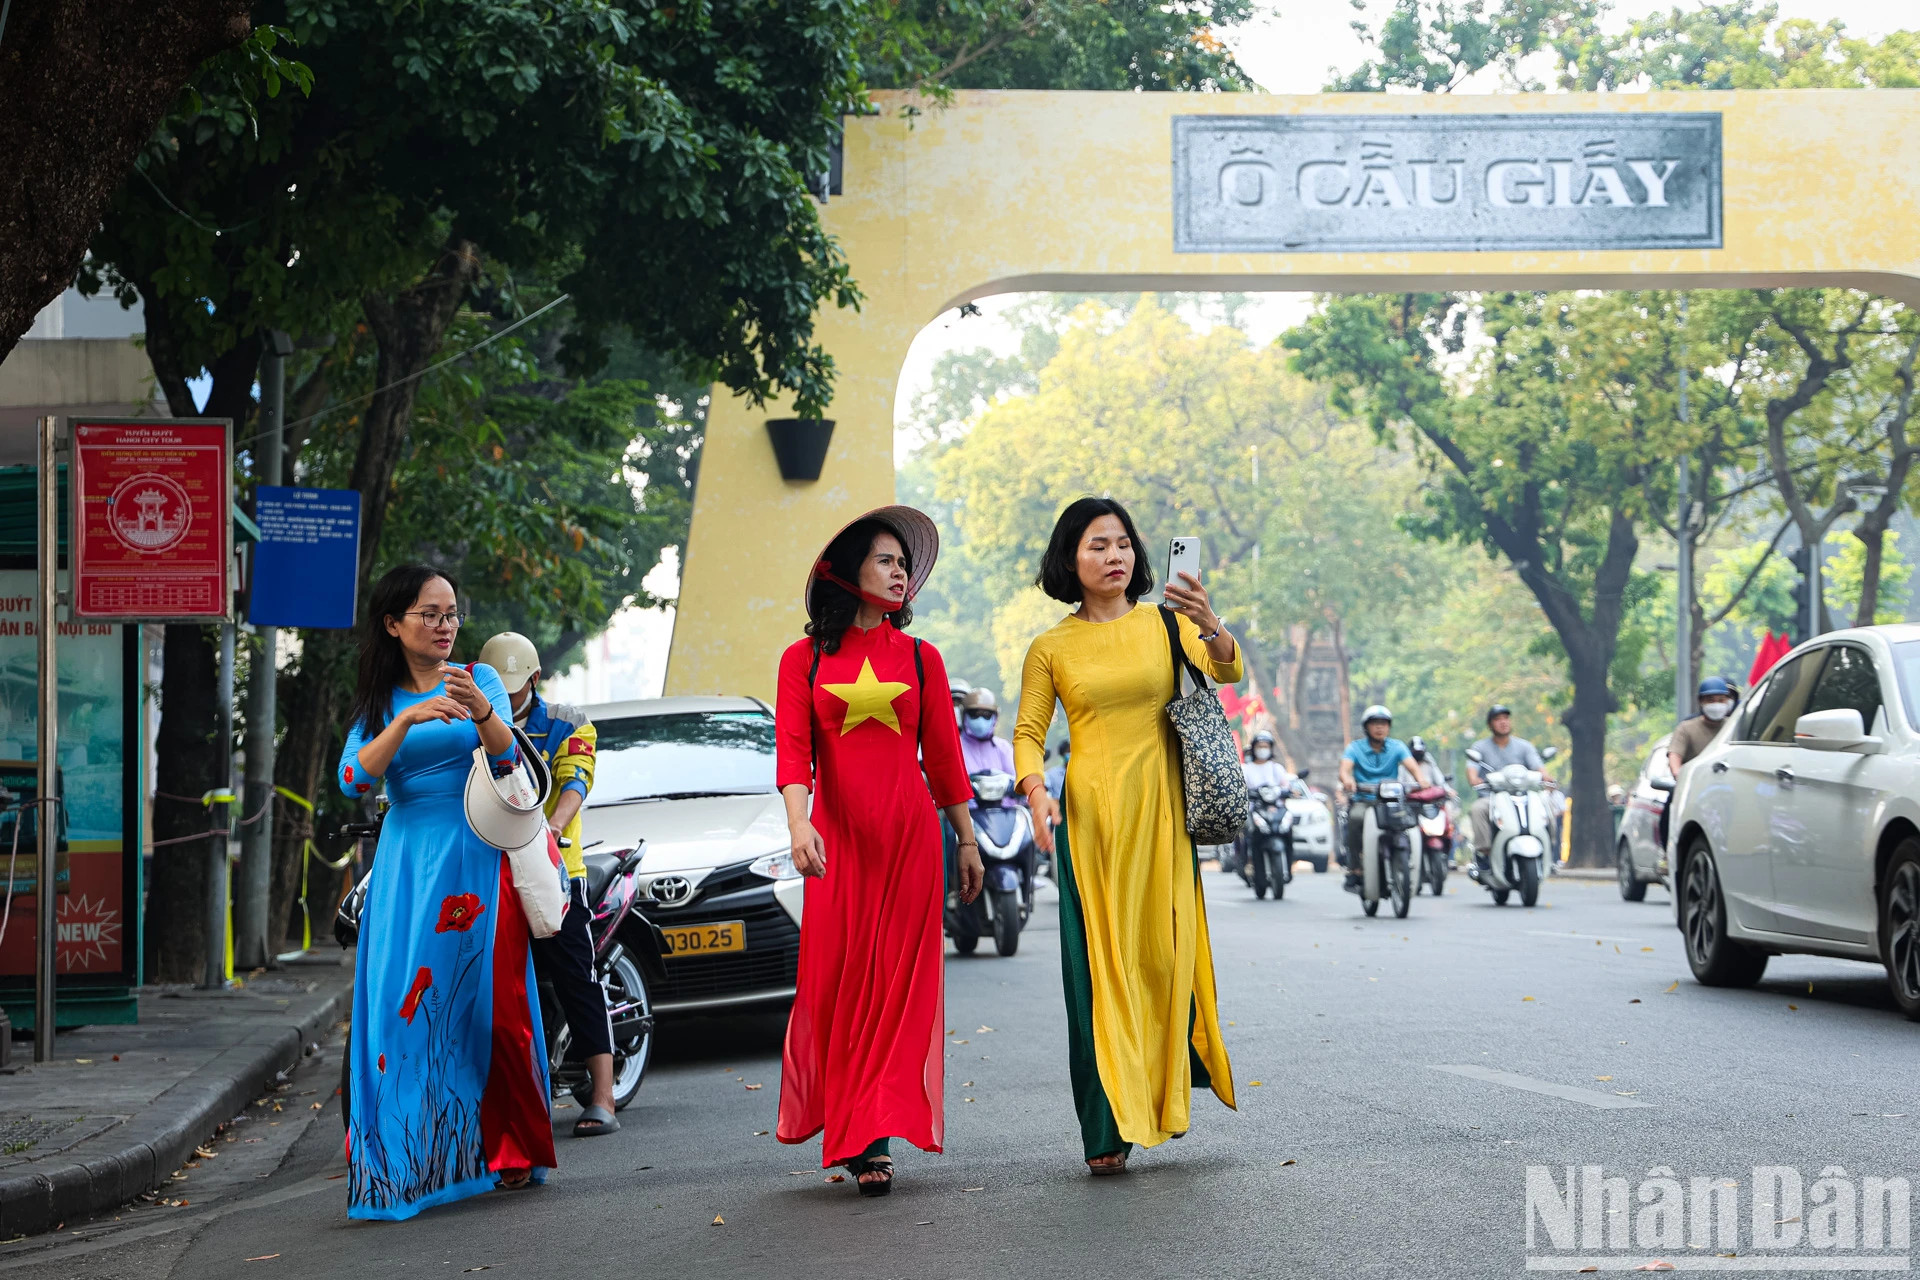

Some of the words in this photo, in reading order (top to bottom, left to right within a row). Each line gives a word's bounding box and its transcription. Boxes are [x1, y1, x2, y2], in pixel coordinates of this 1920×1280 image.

[1218, 147, 1277, 208] Ô
[1296, 142, 1465, 208] CẦU
[1484, 140, 1681, 208] GIẤY
[57, 923, 101, 941] NEW
